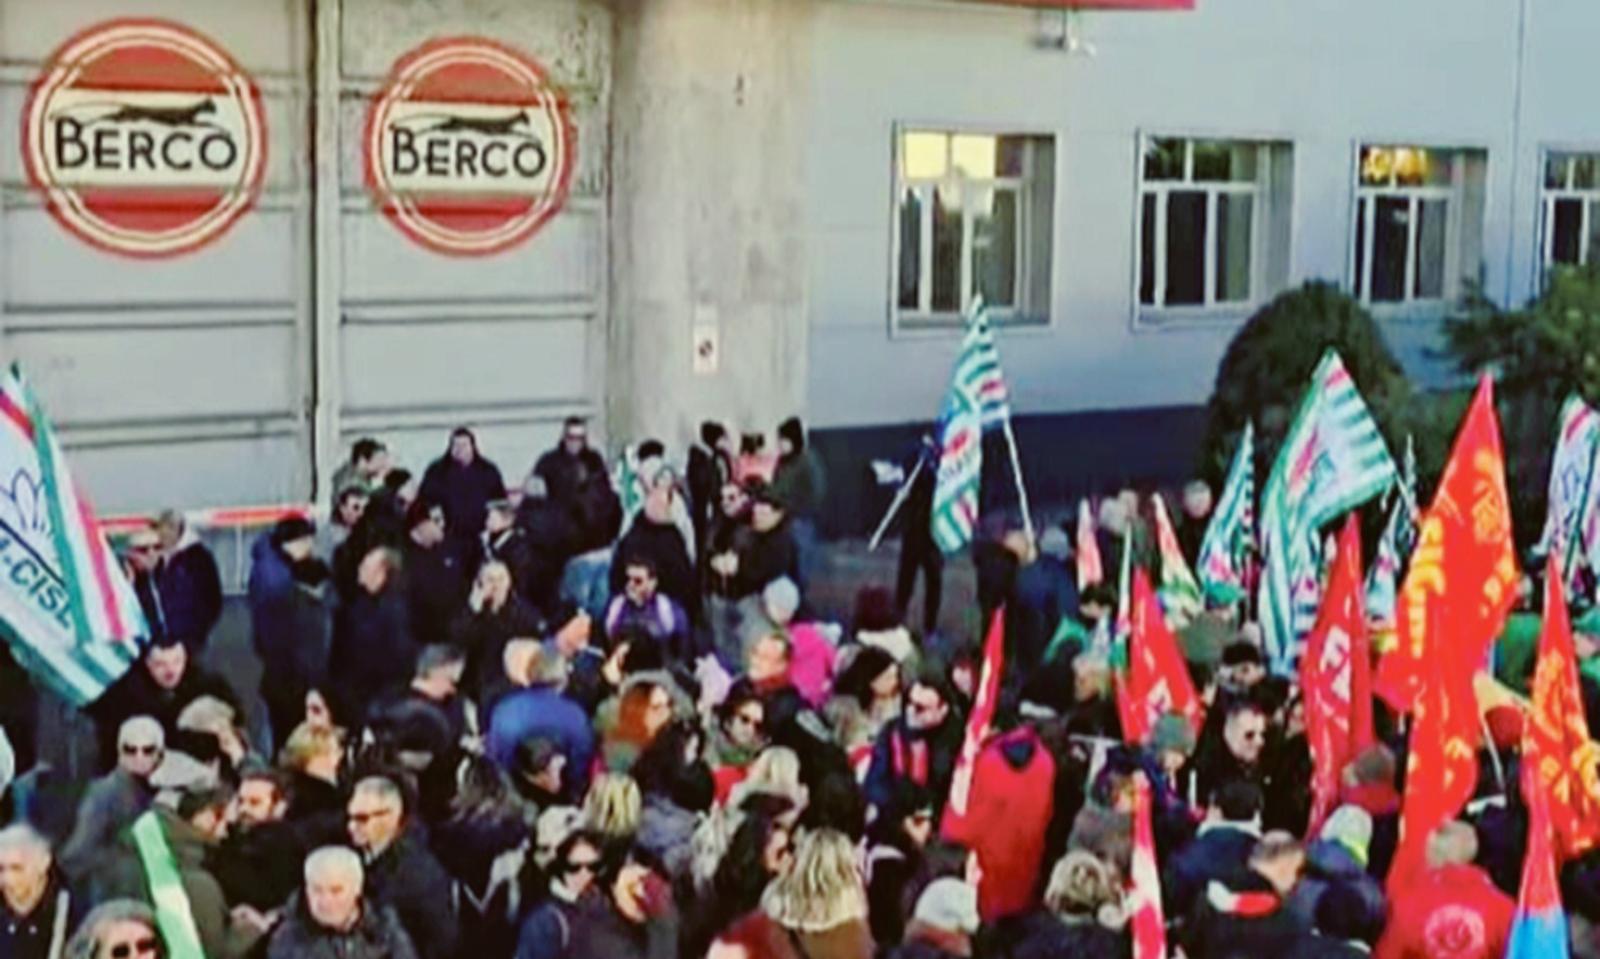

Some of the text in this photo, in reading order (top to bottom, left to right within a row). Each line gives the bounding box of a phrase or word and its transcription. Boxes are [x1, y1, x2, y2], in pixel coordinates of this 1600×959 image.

[55, 116, 237, 171] BERCO
[392, 127, 546, 177] BERCO
[0, 537, 71, 630] .CISL
